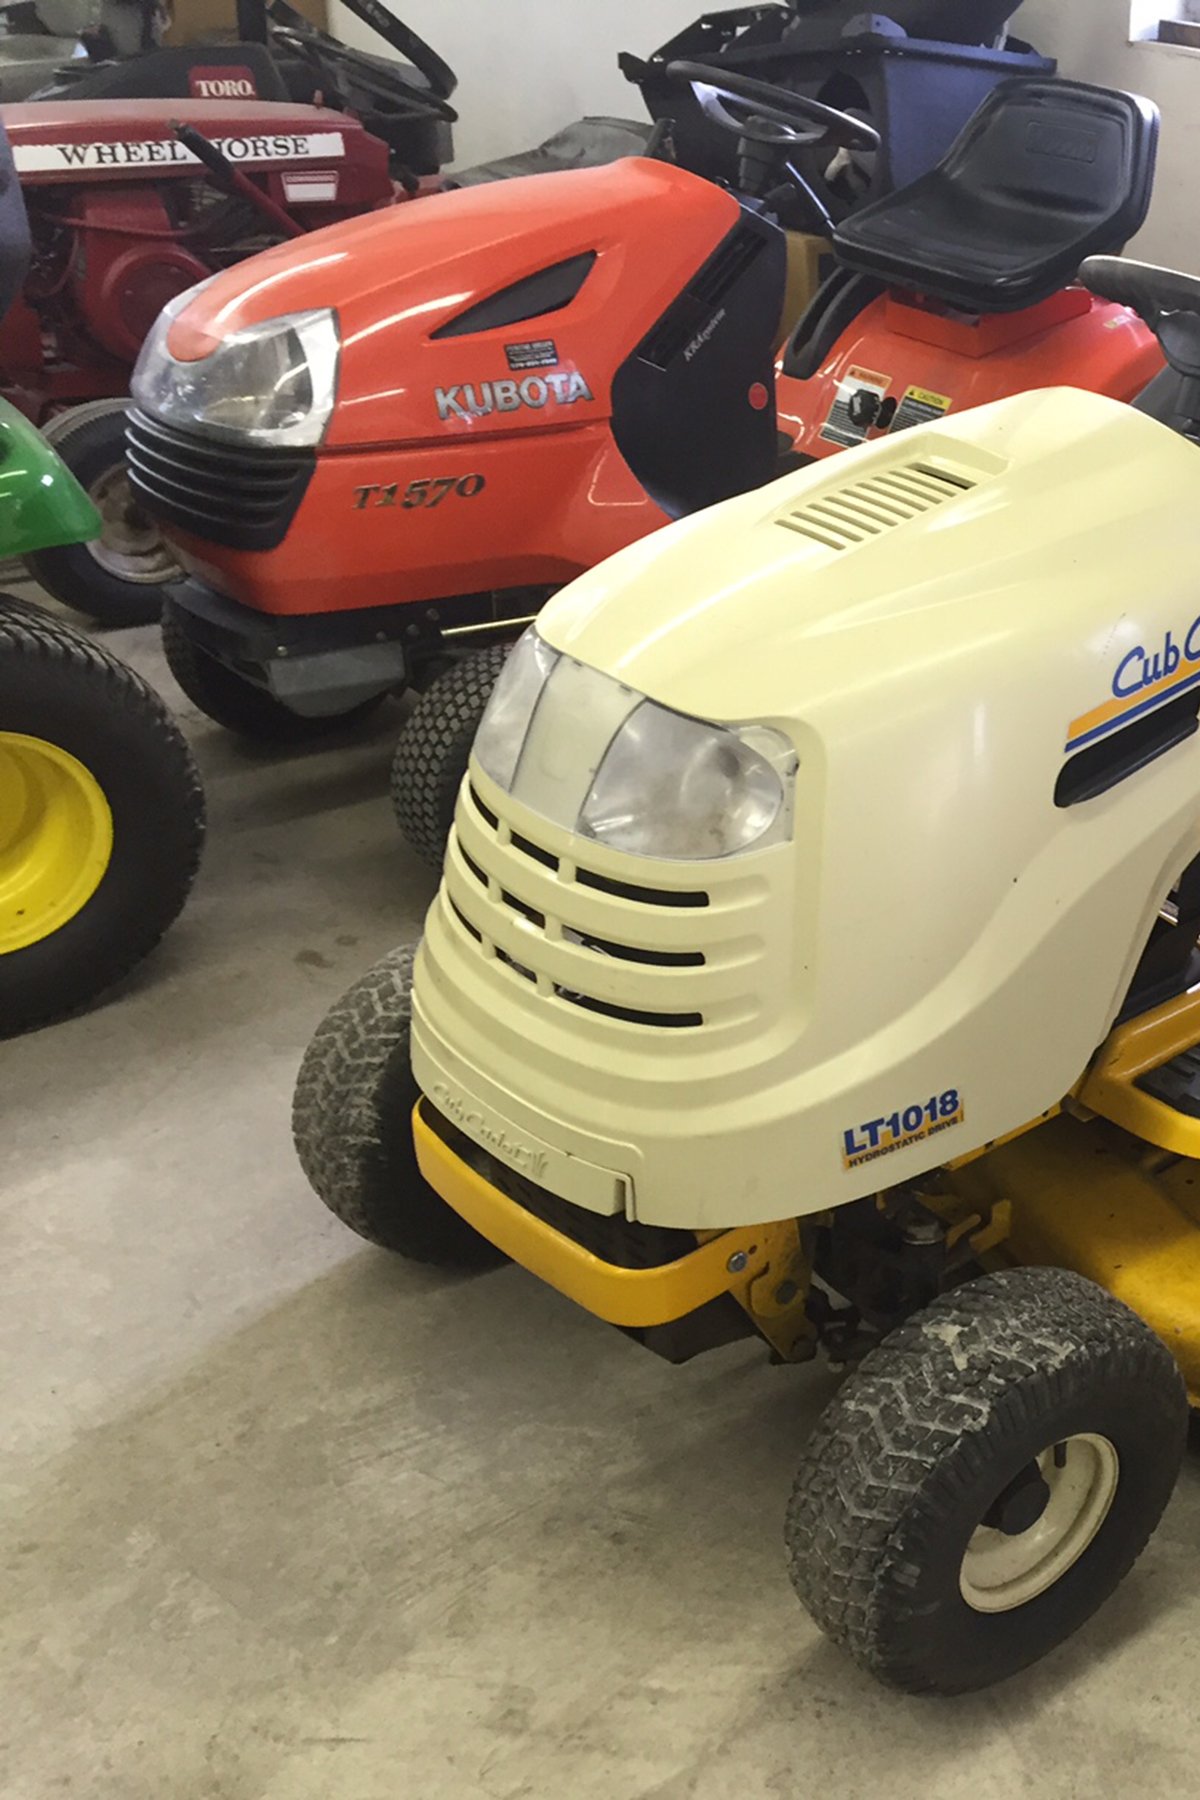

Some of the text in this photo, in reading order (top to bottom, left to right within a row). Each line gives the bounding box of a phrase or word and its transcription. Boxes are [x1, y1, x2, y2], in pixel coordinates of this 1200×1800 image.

[195, 79, 252, 97] TORO
[58, 141, 188, 166] WHEEL
[433, 371, 593, 420] KUBOTA
[351, 473, 486, 511] T1570
[1111, 631, 1181, 699] Cub
[843, 1088, 959, 1156] LT1018
[849, 1115, 958, 1168] HYDROSTATIC DRIVE
